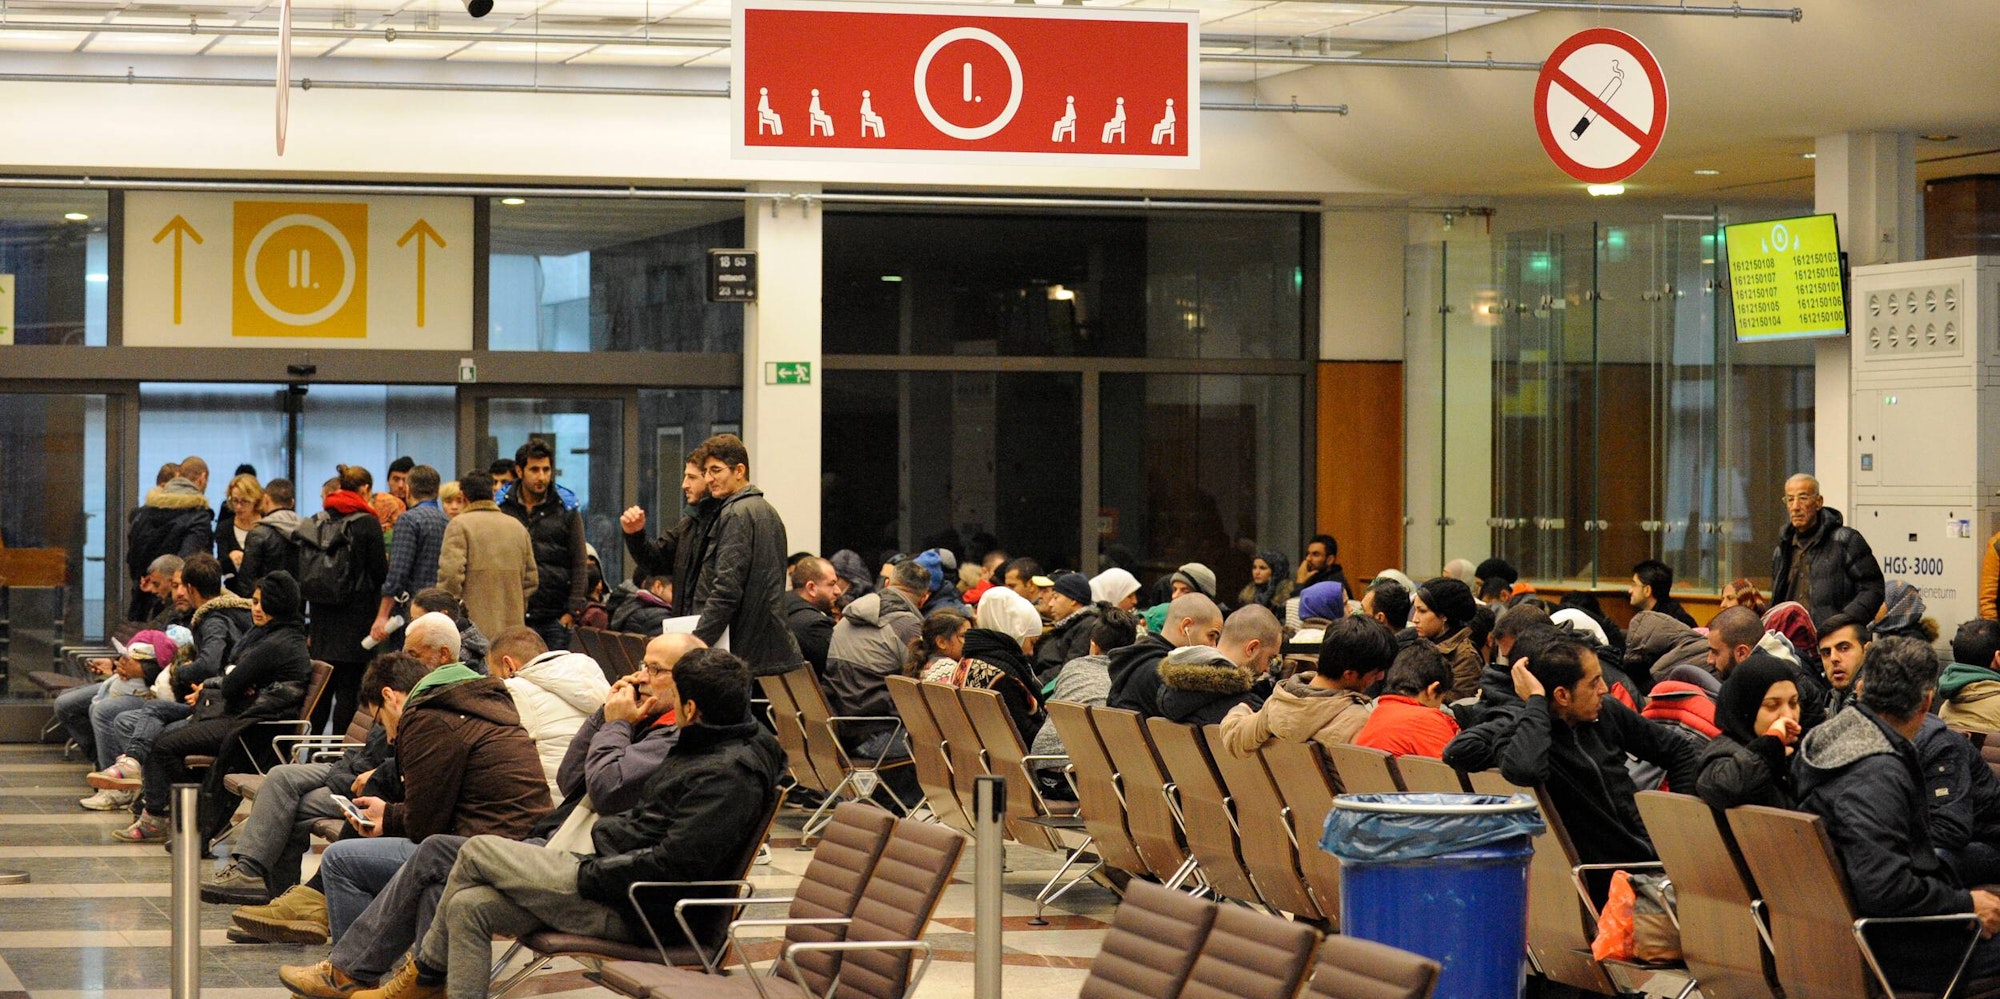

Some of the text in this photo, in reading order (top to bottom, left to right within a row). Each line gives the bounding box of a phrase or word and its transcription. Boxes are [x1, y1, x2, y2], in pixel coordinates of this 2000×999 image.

[1733, 258, 1775, 272] 1612150108
[1793, 252, 1837, 266] 1612150103
[288, 249, 320, 289] II.
[1794, 266, 1839, 281] 1612150102
[1734, 272, 1776, 286] 1612150107
[1736, 287, 1777, 301] 1612150107
[1796, 281, 1840, 295] 1612150101
[1737, 301, 1780, 315] 1612150105
[1798, 296, 1842, 310] 1612150106
[1739, 316, 1781, 329] 1612150104
[1799, 311, 1844, 324] 1612150100
